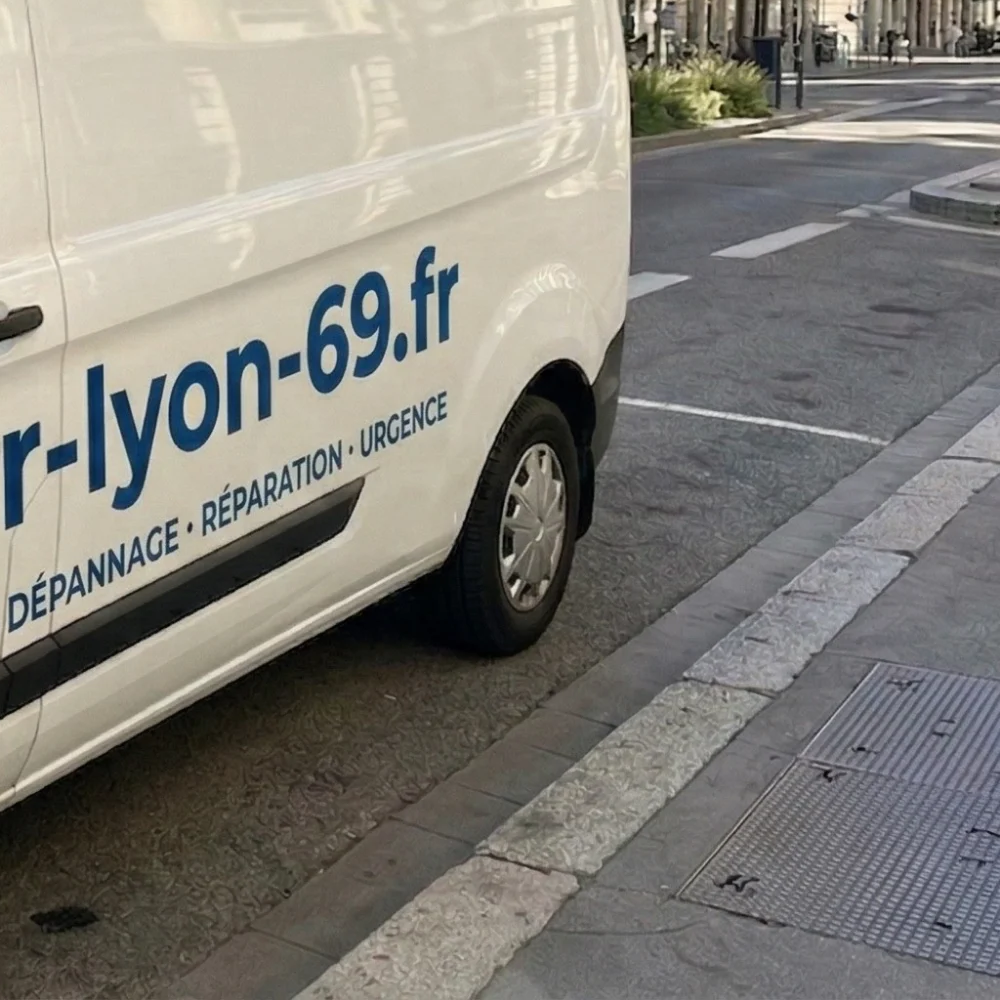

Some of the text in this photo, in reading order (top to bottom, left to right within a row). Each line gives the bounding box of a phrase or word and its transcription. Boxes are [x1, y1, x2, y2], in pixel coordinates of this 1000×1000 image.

[8, 517, 180, 634] DÉPANNAGE
[202, 439, 342, 537] RÉPARATION
[360, 391, 448, 458] URGENCE
